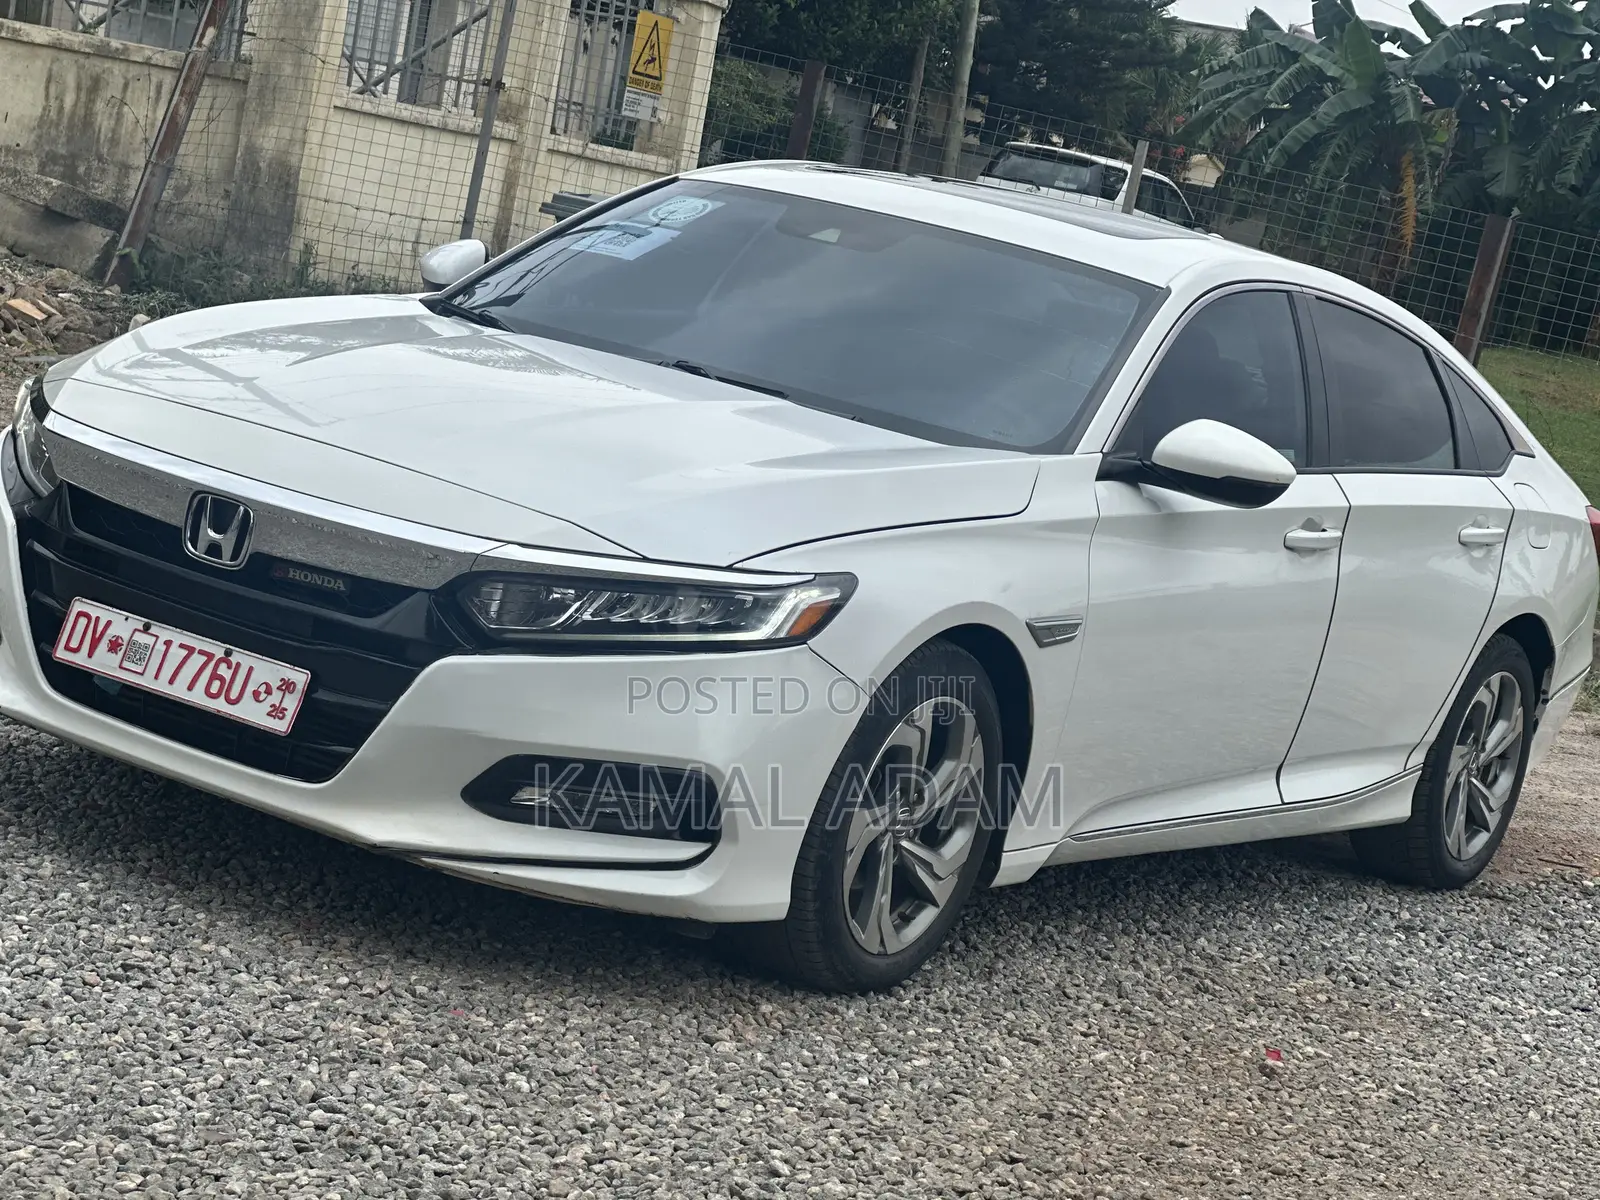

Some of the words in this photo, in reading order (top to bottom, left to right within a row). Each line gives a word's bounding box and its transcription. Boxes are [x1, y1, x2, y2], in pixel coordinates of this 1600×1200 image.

[287, 567, 346, 591] HONDA
[63, 610, 113, 658] DV
[154, 639, 254, 706] 1776U
[266, 703, 288, 720] 25
